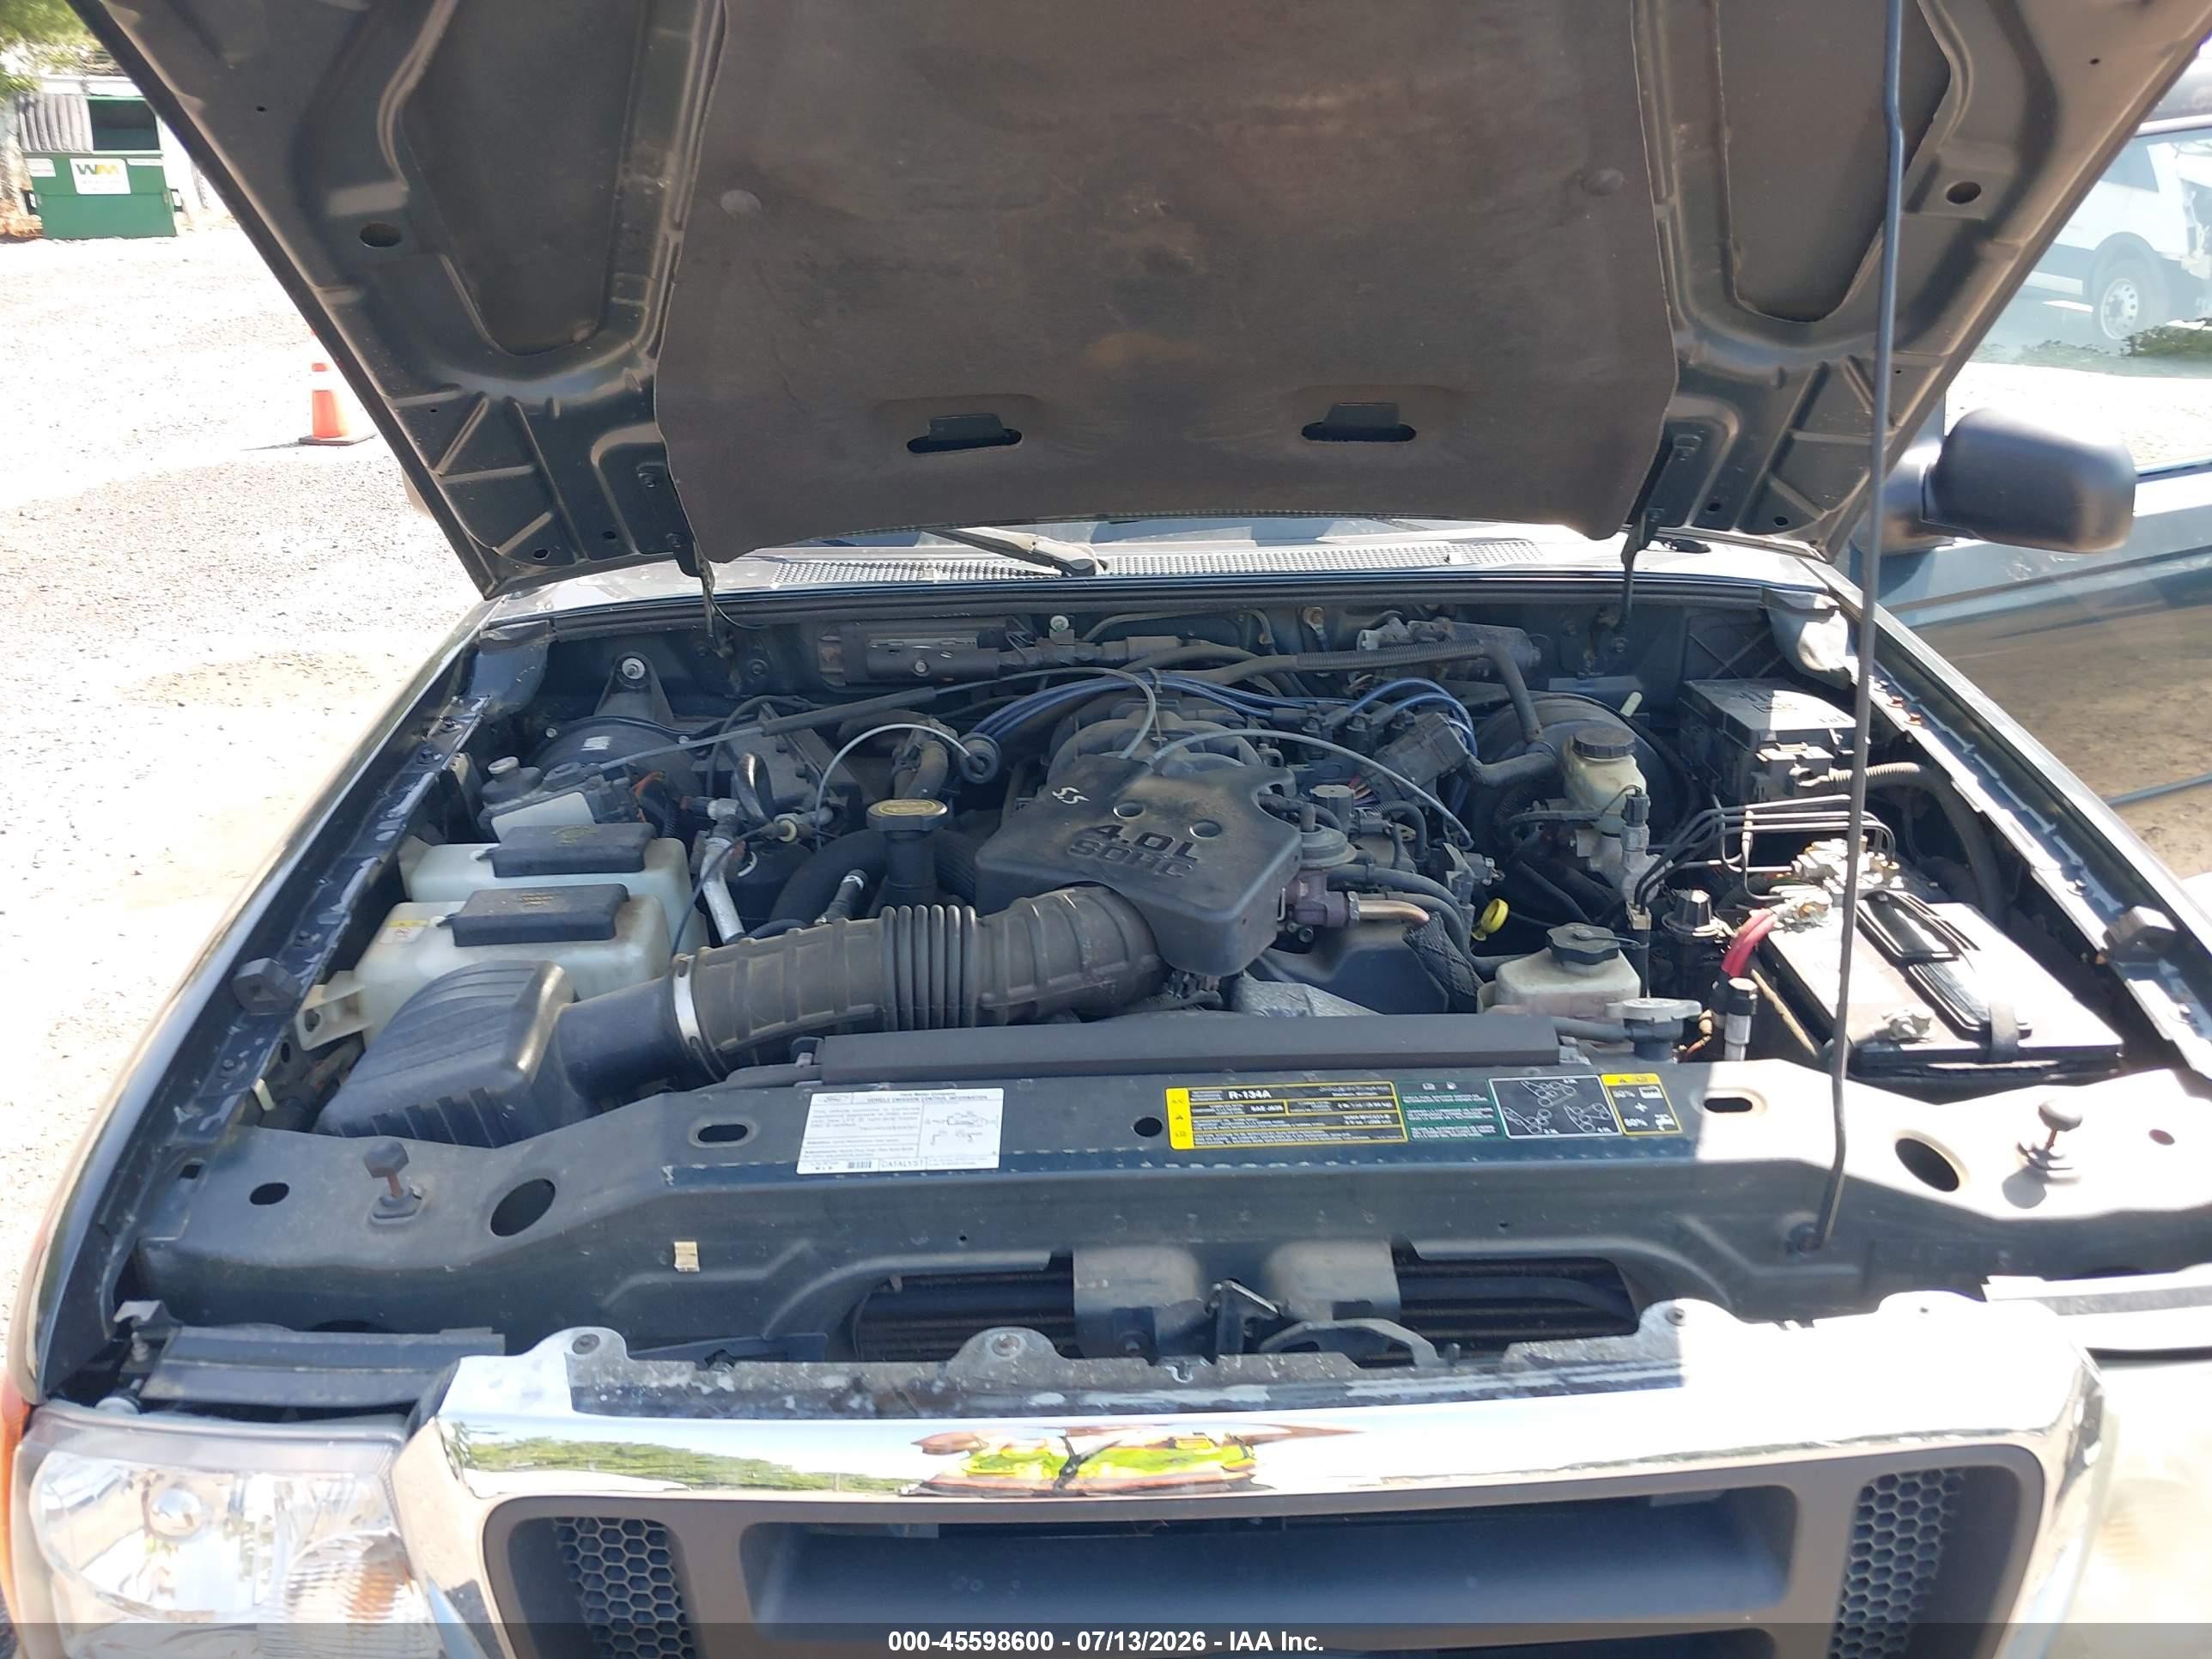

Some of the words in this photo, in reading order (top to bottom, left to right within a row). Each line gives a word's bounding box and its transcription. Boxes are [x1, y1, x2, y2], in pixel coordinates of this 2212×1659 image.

[76, 163, 121, 176] WM
[1088, 823, 1199, 862] 4.0L
[1065, 838, 1194, 878] SOHC
[1228, 1090, 1272, 1100] R-134A
[881, 1159, 924, 1169] CATALYST
